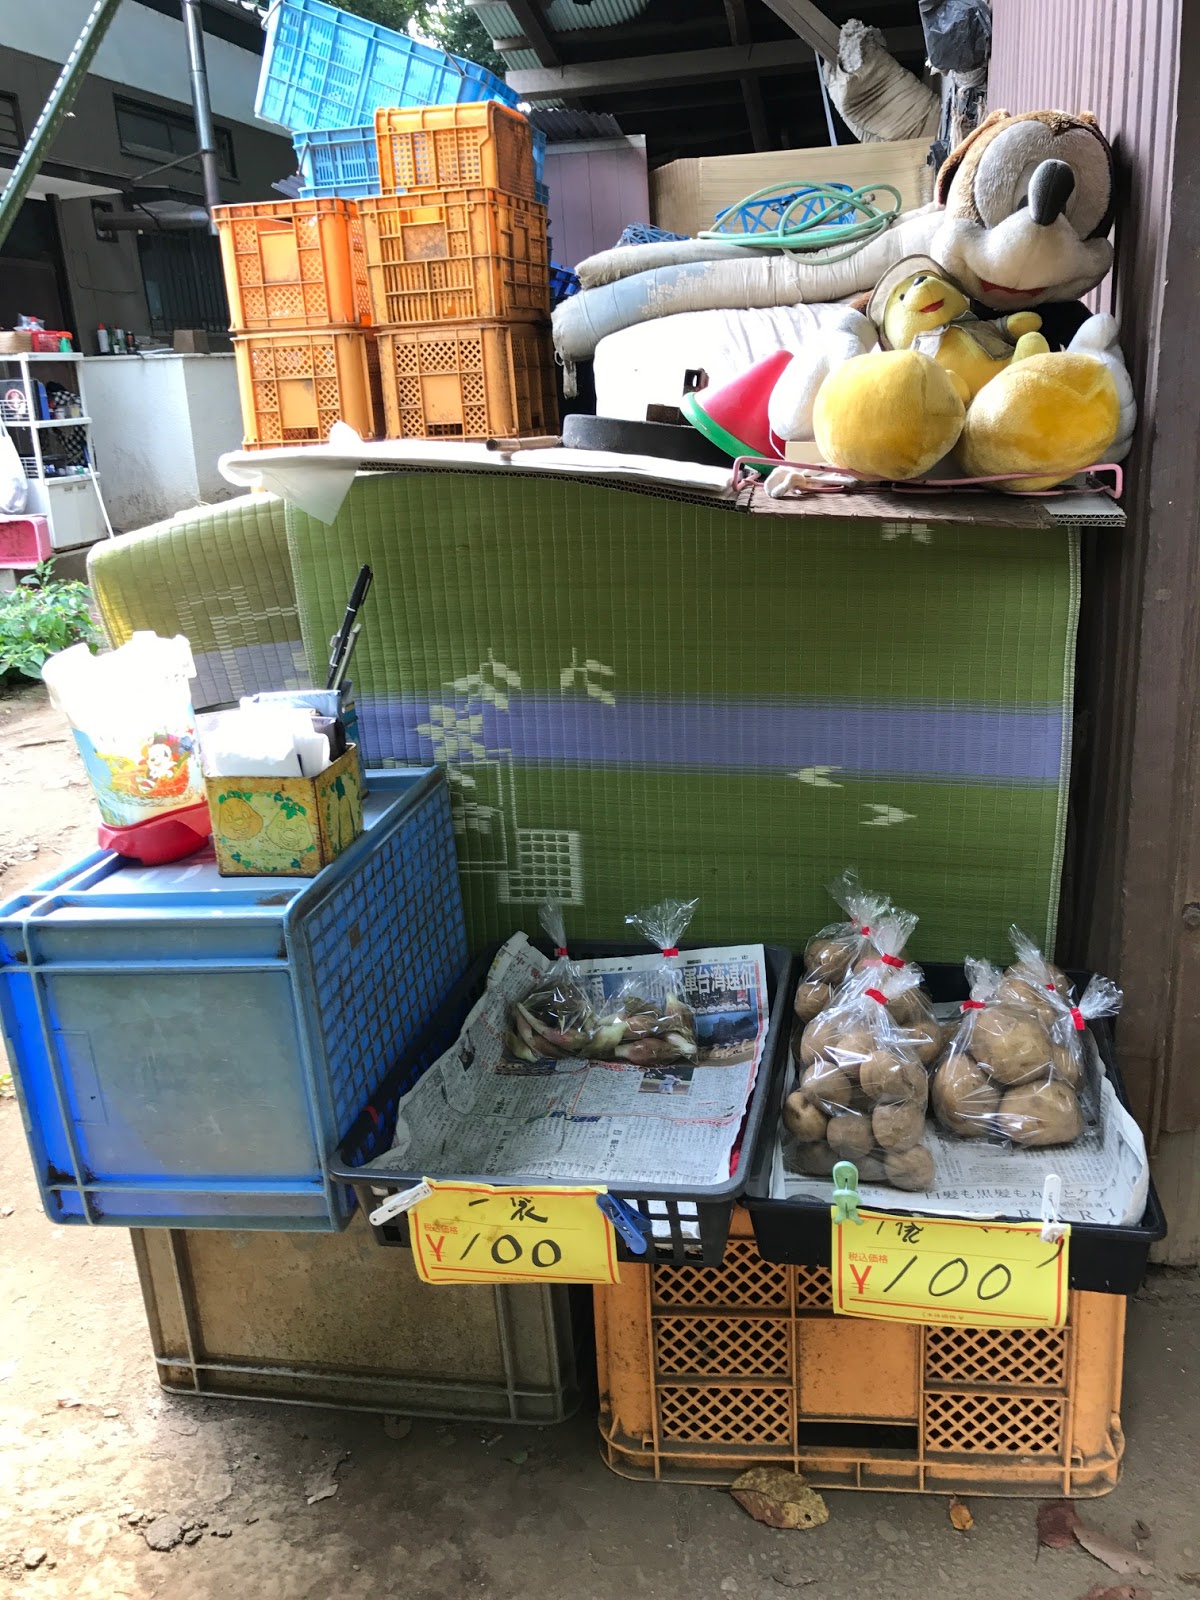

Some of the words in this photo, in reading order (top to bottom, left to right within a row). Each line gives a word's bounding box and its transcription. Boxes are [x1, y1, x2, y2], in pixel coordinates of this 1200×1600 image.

[925, 1187, 1108, 1200] 白髪も黒髪も丸とケア
[848, 1251, 889, 1264] 税込価格
